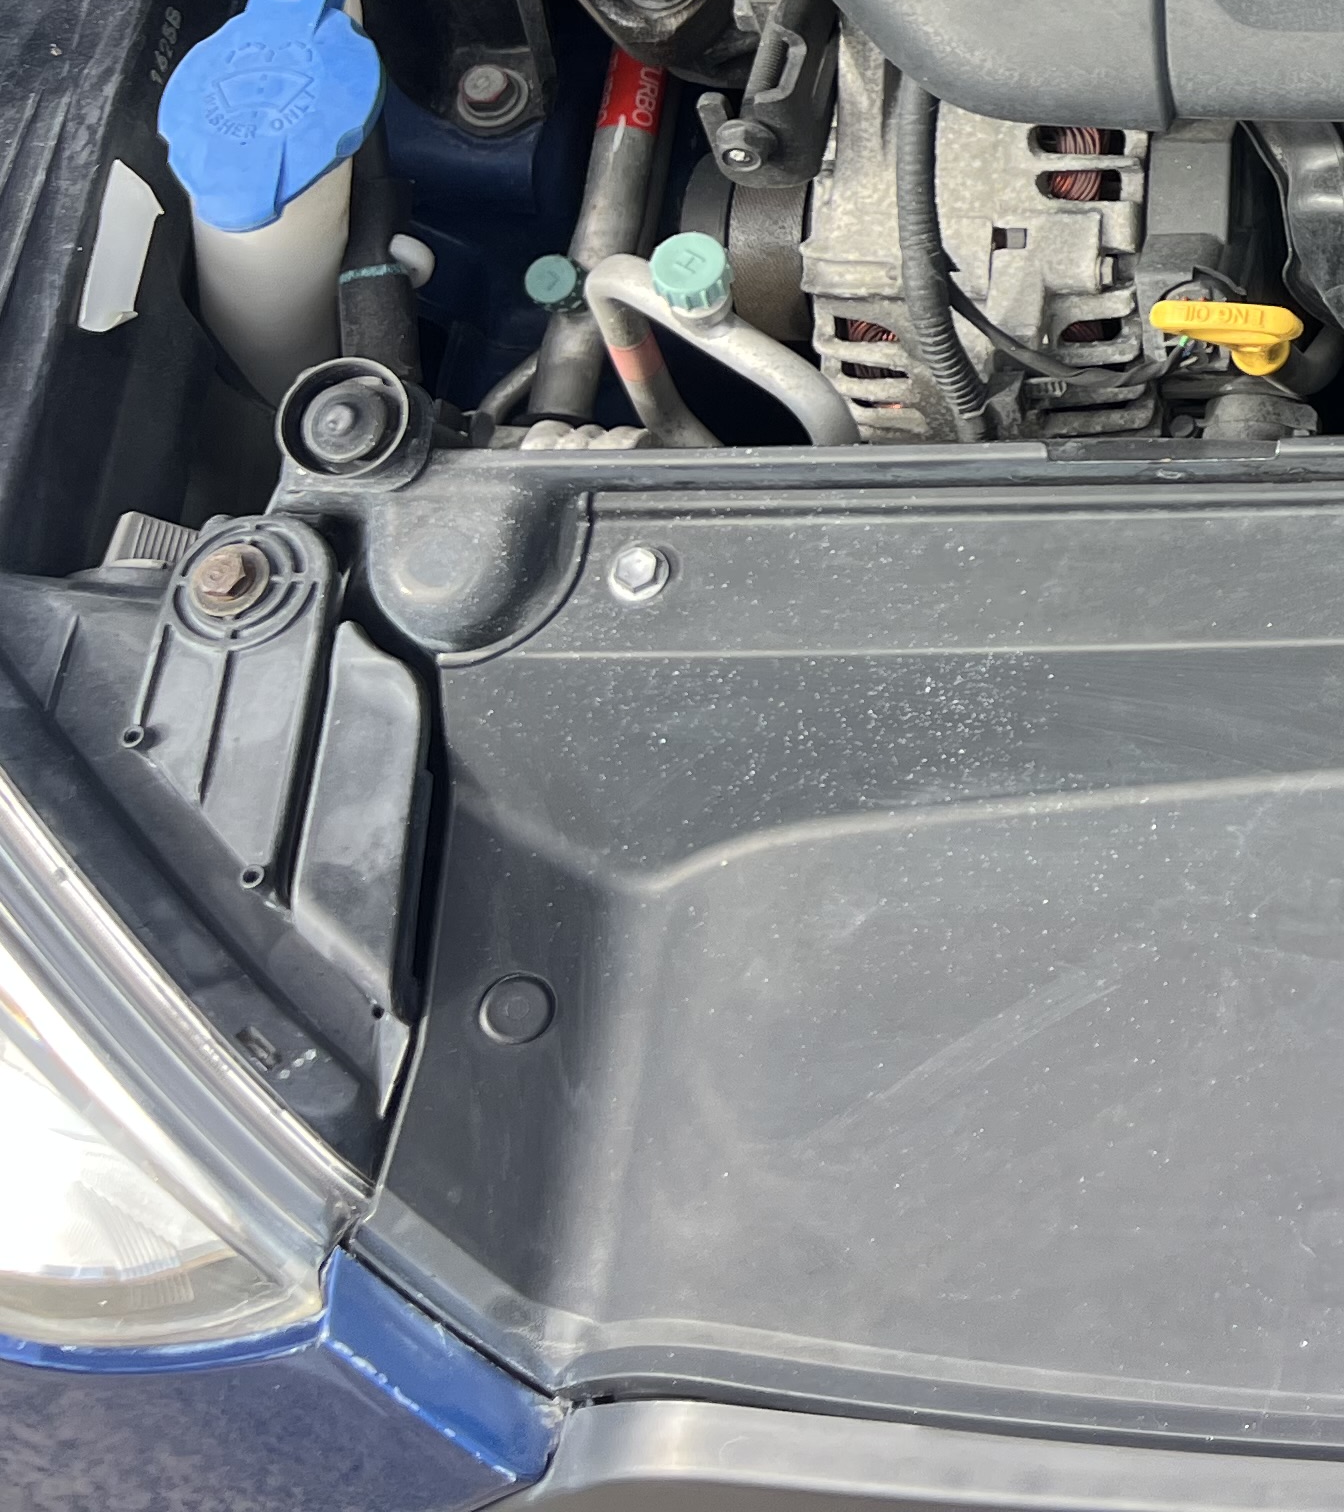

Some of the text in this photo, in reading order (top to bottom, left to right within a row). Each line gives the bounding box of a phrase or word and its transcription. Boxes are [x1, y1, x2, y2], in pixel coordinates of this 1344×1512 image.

[203, 89, 317, 140] WASHER ONLY
[632, 65, 662, 127] URBO
[673, 248, 707, 276] H
[1175, 305, 1266, 329] ENG OIL
